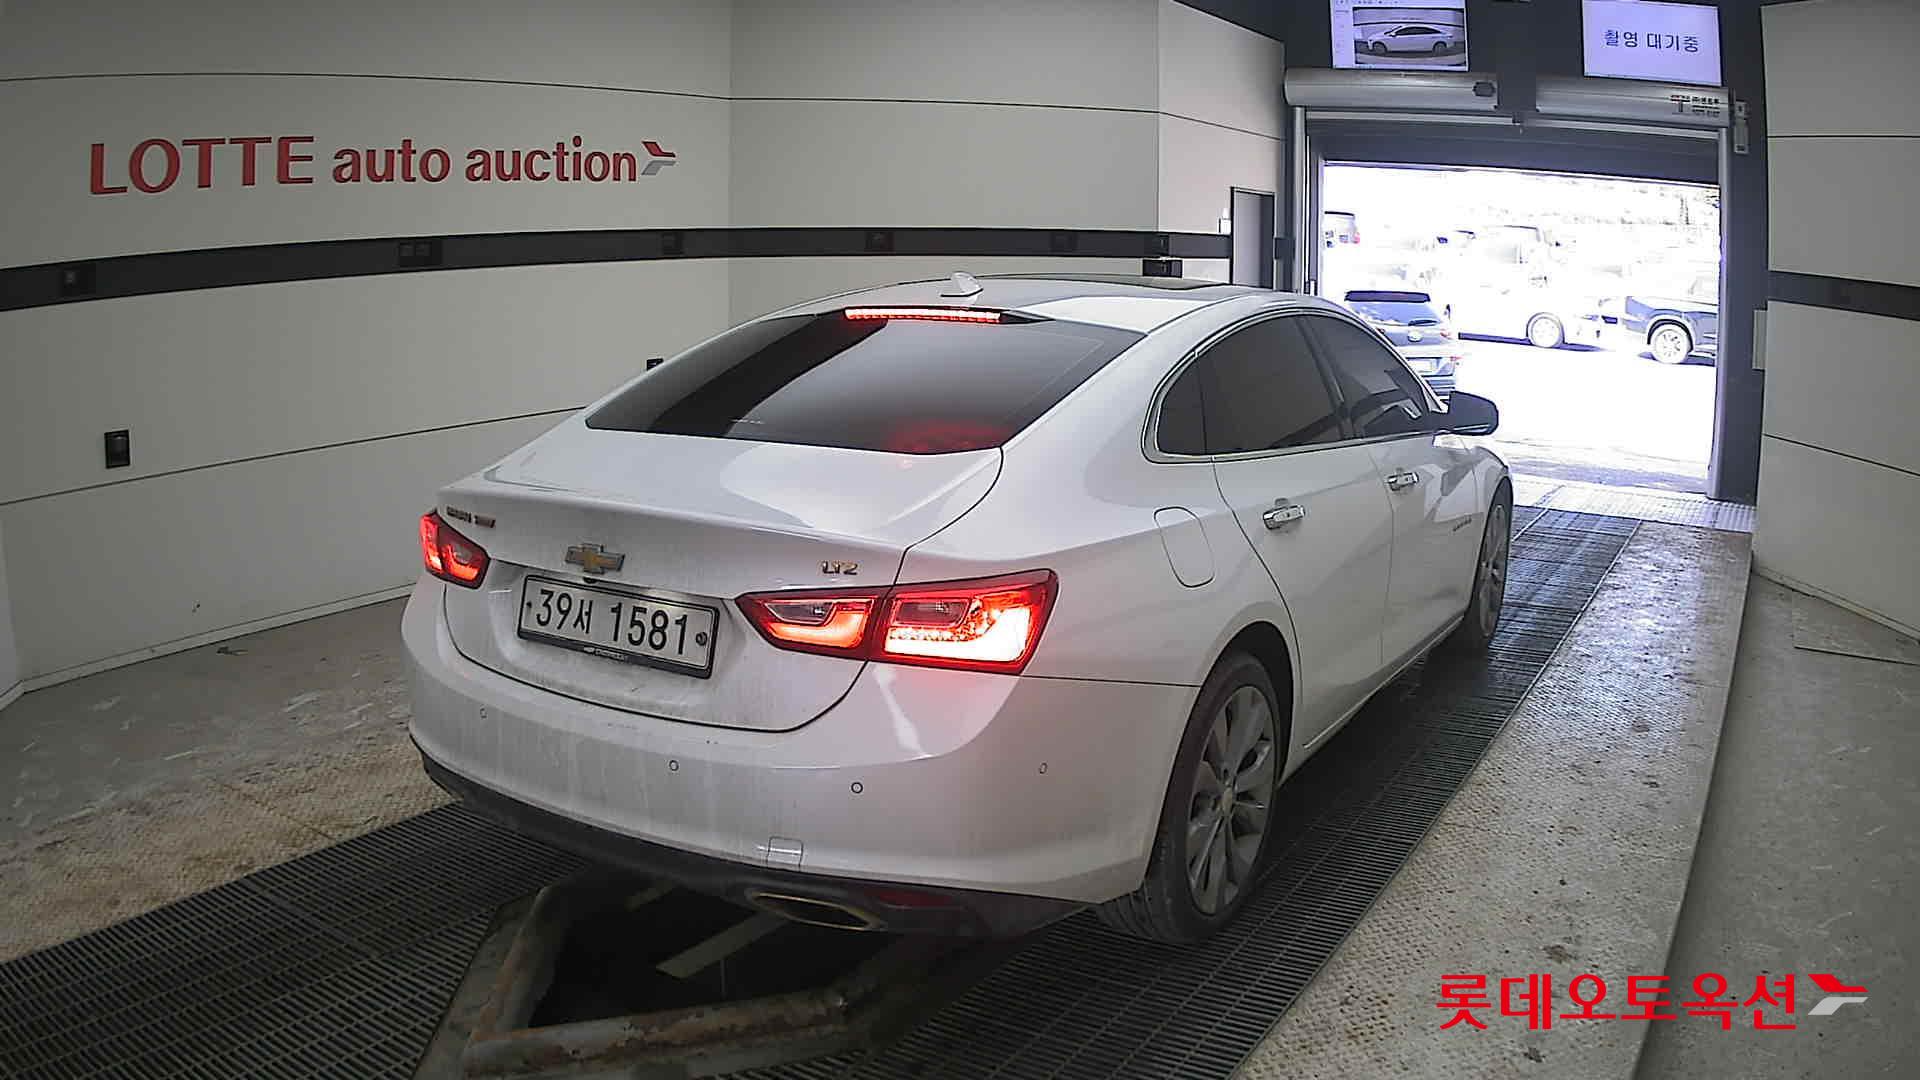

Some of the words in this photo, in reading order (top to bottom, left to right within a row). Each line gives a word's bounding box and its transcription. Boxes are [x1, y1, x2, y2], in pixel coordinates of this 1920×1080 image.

[1646, 33, 1699, 52] 대기중
[90, 136, 314, 196] LOTTE
[332, 138, 451, 183] auto
[465, 135, 637, 182] auction
[536, 588, 593, 634] 39서
[610, 602, 688, 655] 1581
